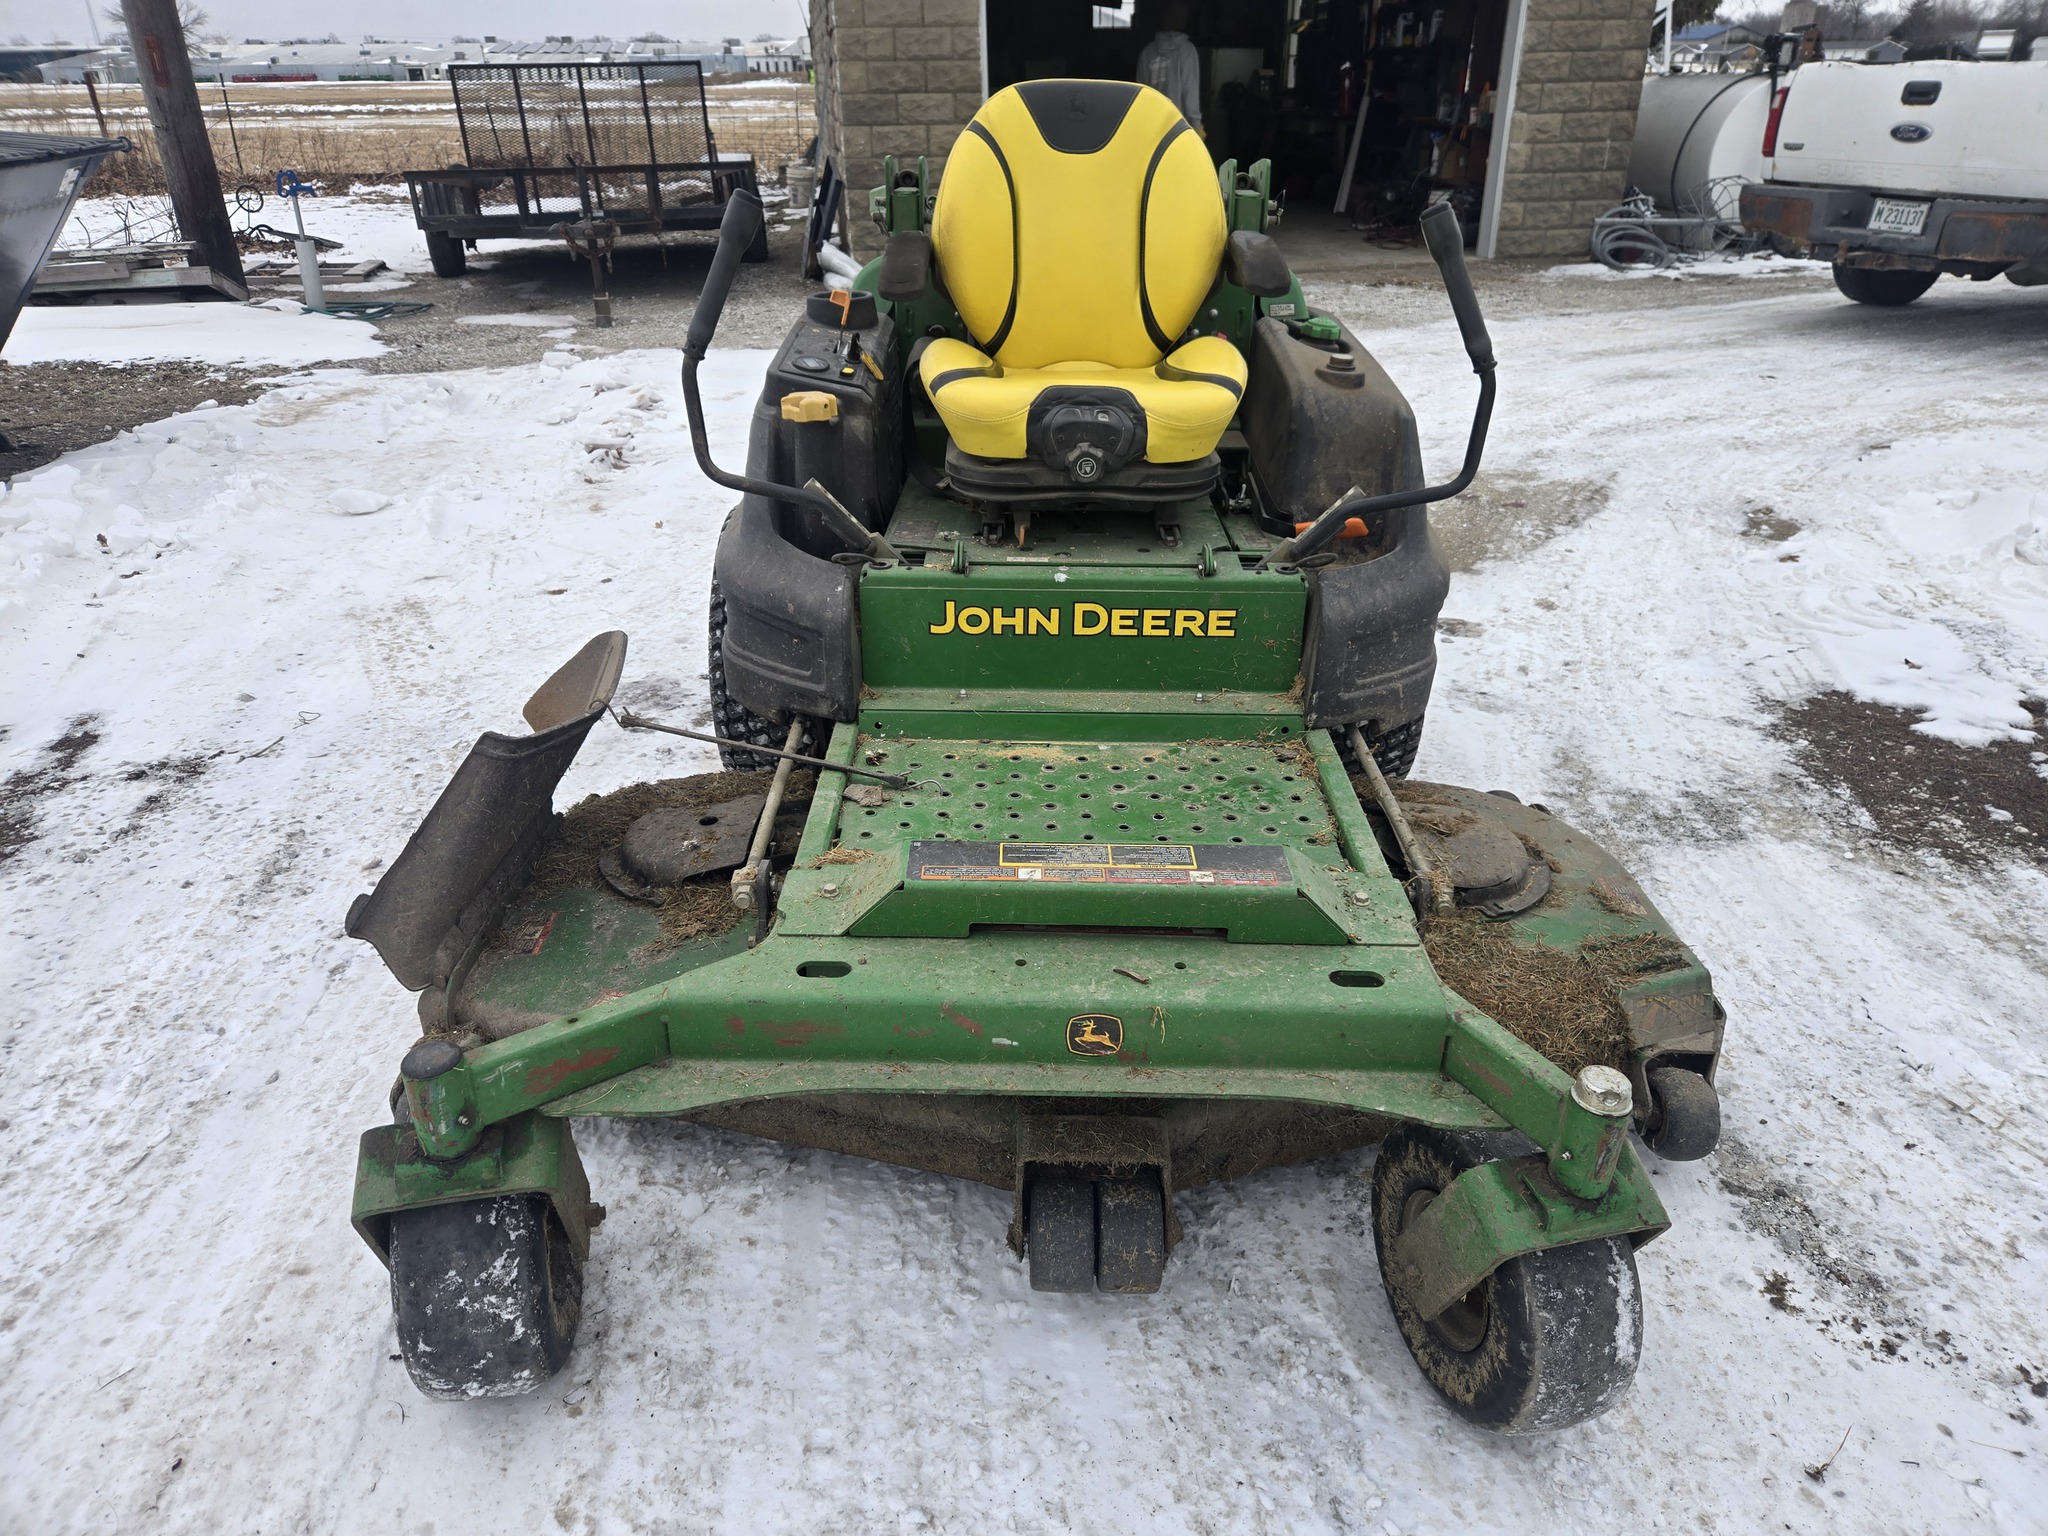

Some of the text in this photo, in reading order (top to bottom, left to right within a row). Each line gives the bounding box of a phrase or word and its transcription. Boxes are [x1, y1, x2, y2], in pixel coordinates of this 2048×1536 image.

[1884, 208, 1925, 227] 231137
[929, 600, 1239, 639] JOHN DEERE
